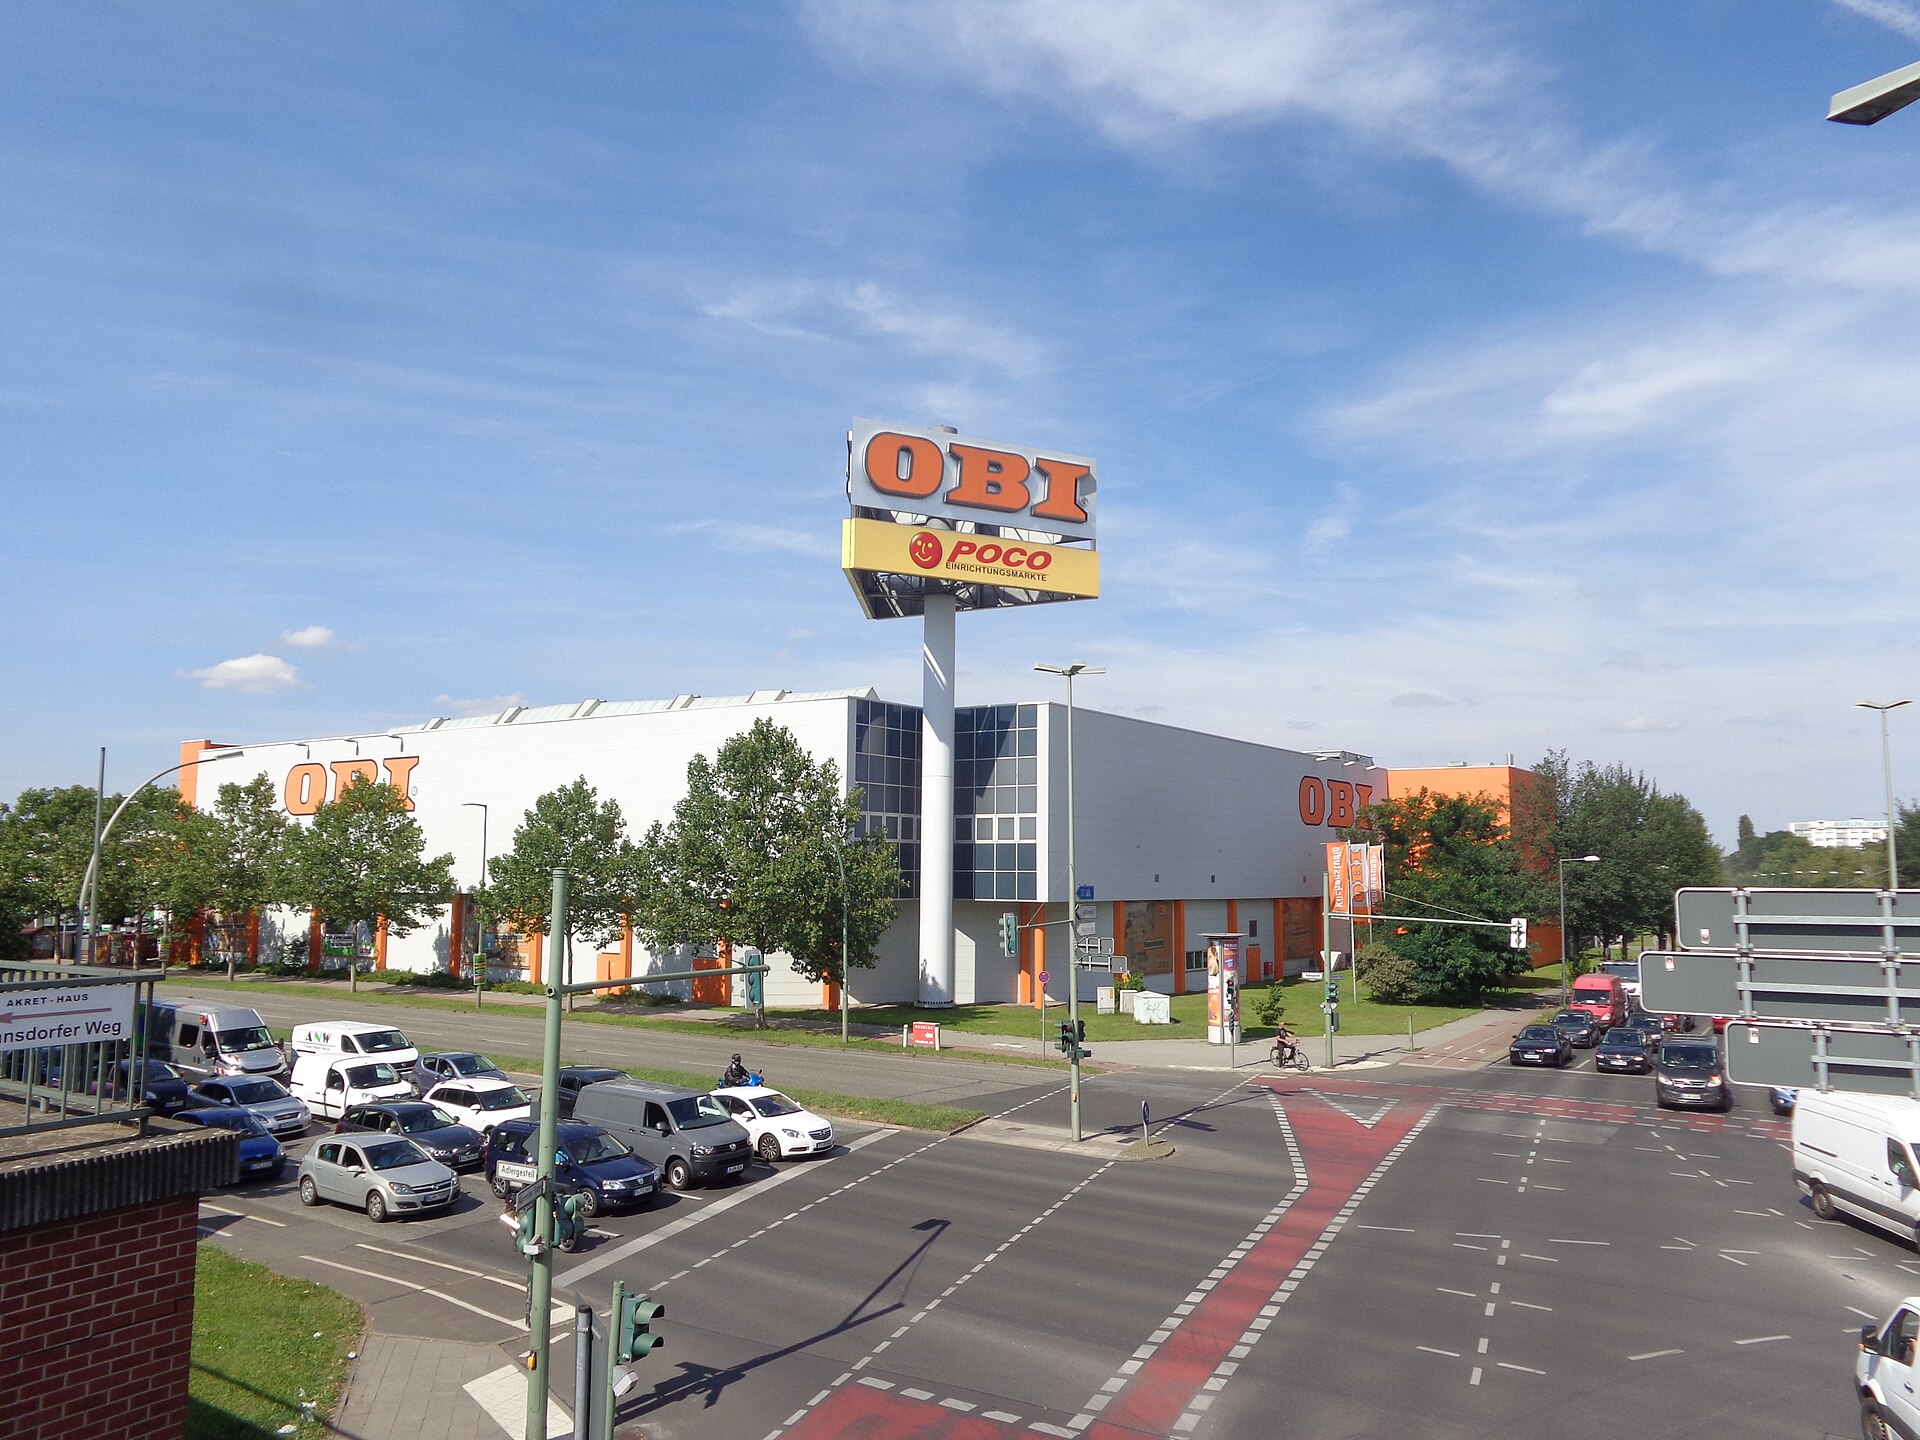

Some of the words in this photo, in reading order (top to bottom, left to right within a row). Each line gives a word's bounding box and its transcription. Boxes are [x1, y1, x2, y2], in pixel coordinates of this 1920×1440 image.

[863, 431, 1089, 524] OBI
[946, 540, 1052, 571] POCO
[1298, 775, 1373, 829] OBI
[85, 1020, 122, 1036] Weg
[501, 1164, 535, 1179] Adlergestell
